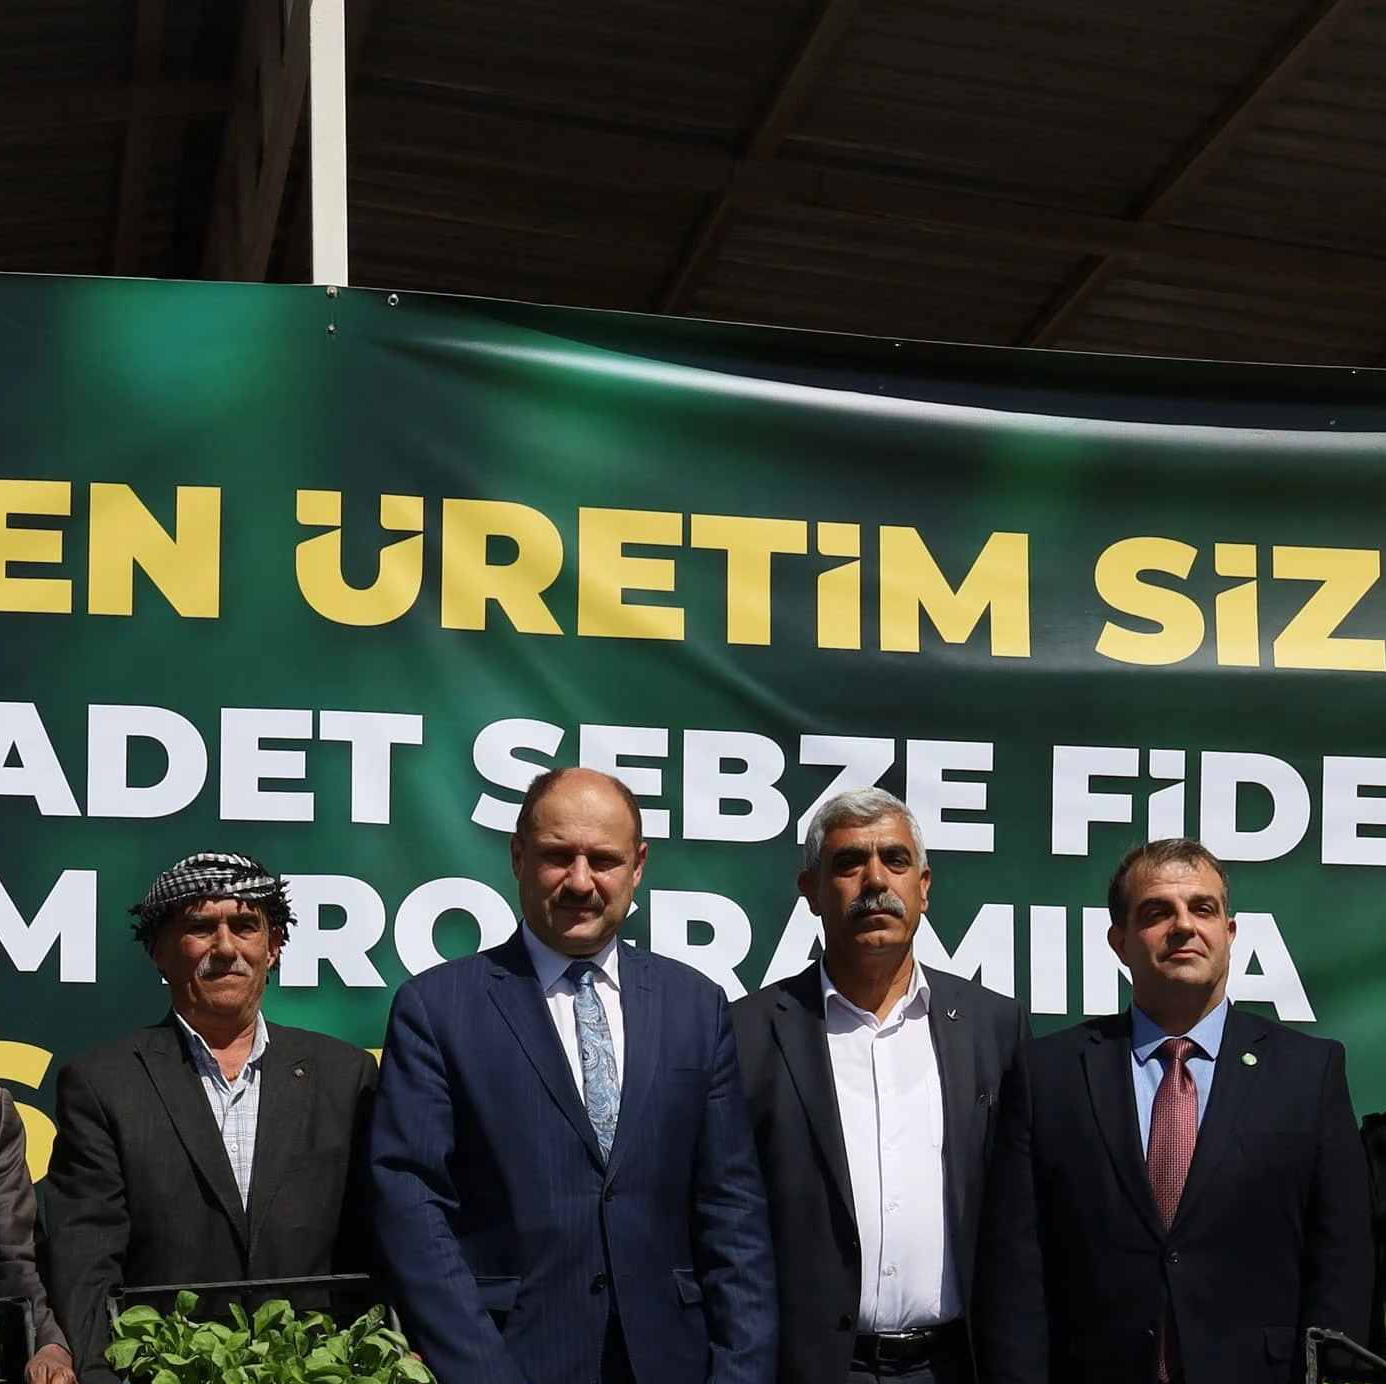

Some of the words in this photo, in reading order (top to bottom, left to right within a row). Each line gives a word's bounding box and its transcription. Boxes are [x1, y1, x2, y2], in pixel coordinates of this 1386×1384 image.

[294, 489, 1032, 657] ÜRETİM
[470, 718, 995, 852] SEBZE
[162, 874, 1319, 1022] RORAMIA
